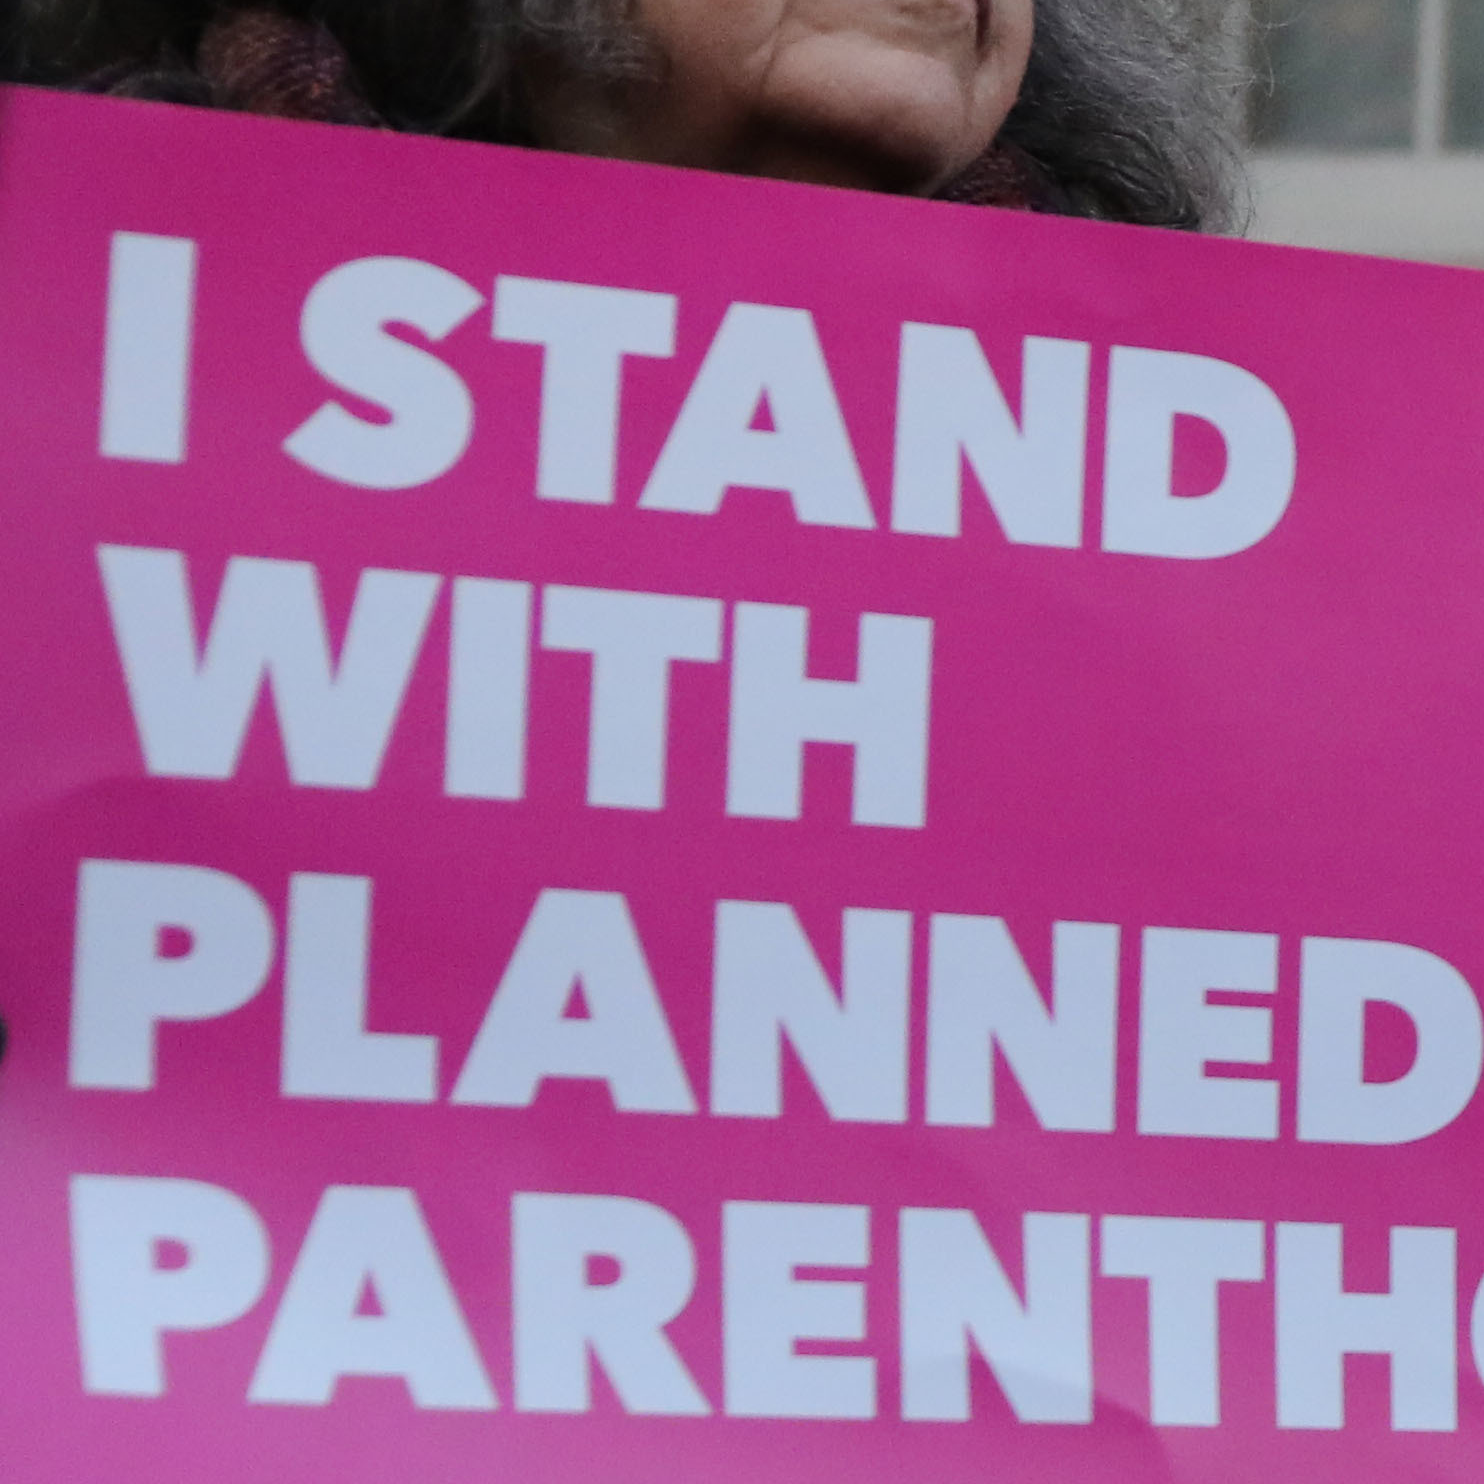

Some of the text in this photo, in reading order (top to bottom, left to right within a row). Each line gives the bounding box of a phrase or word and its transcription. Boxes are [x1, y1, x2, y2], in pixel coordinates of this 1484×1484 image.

[100, 231, 1297, 561] I STAND
[96, 544, 934, 829] WITH
[69, 859, 1484, 1146] PLANNED
